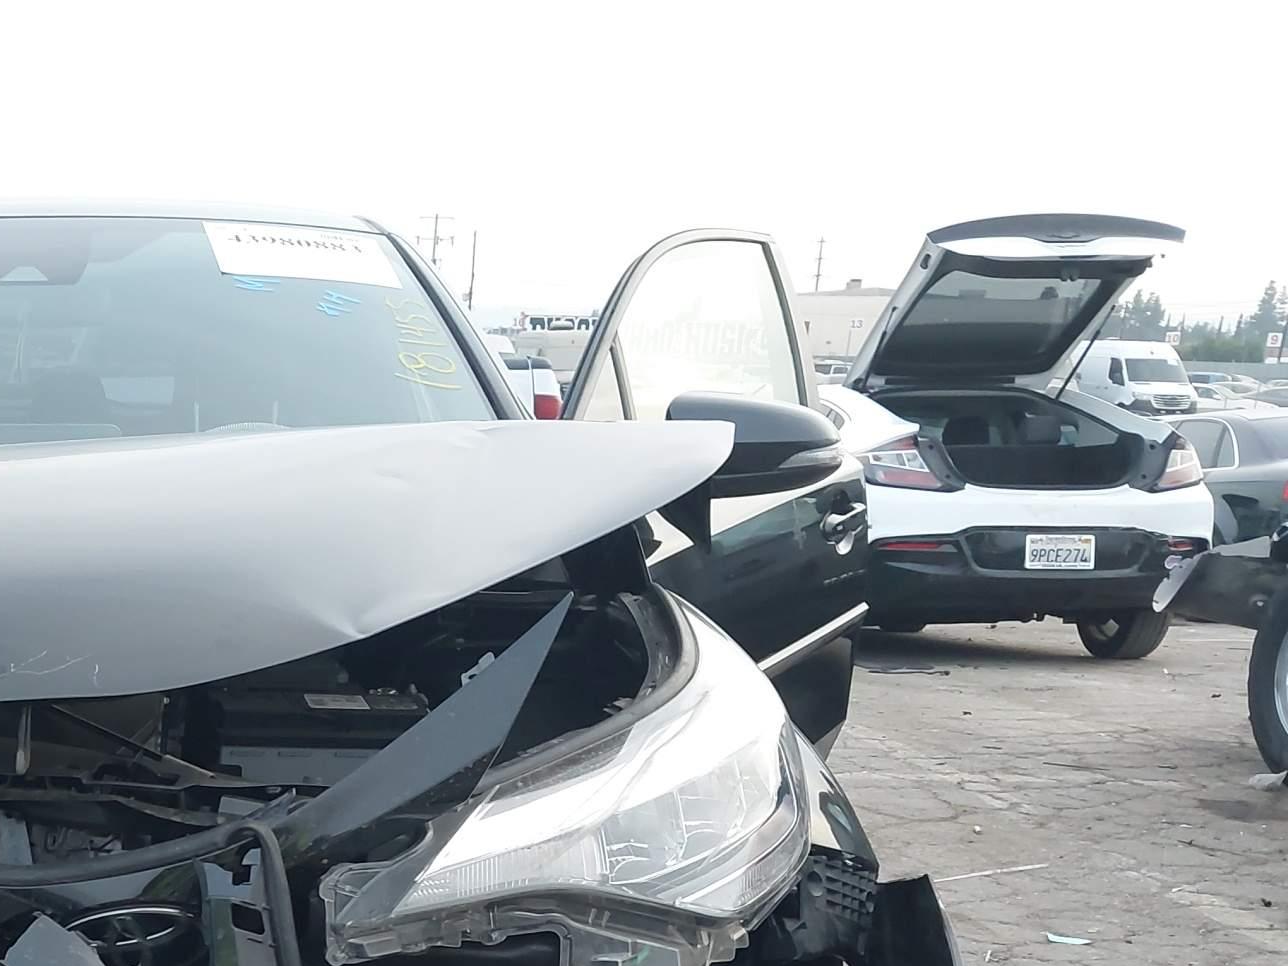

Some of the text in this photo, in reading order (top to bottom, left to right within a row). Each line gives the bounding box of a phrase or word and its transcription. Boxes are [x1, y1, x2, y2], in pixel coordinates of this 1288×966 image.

[850, 319, 864, 329] 13
[1269, 334, 1280, 346] 9
[1030, 548, 1089, 563] 9PCE274
